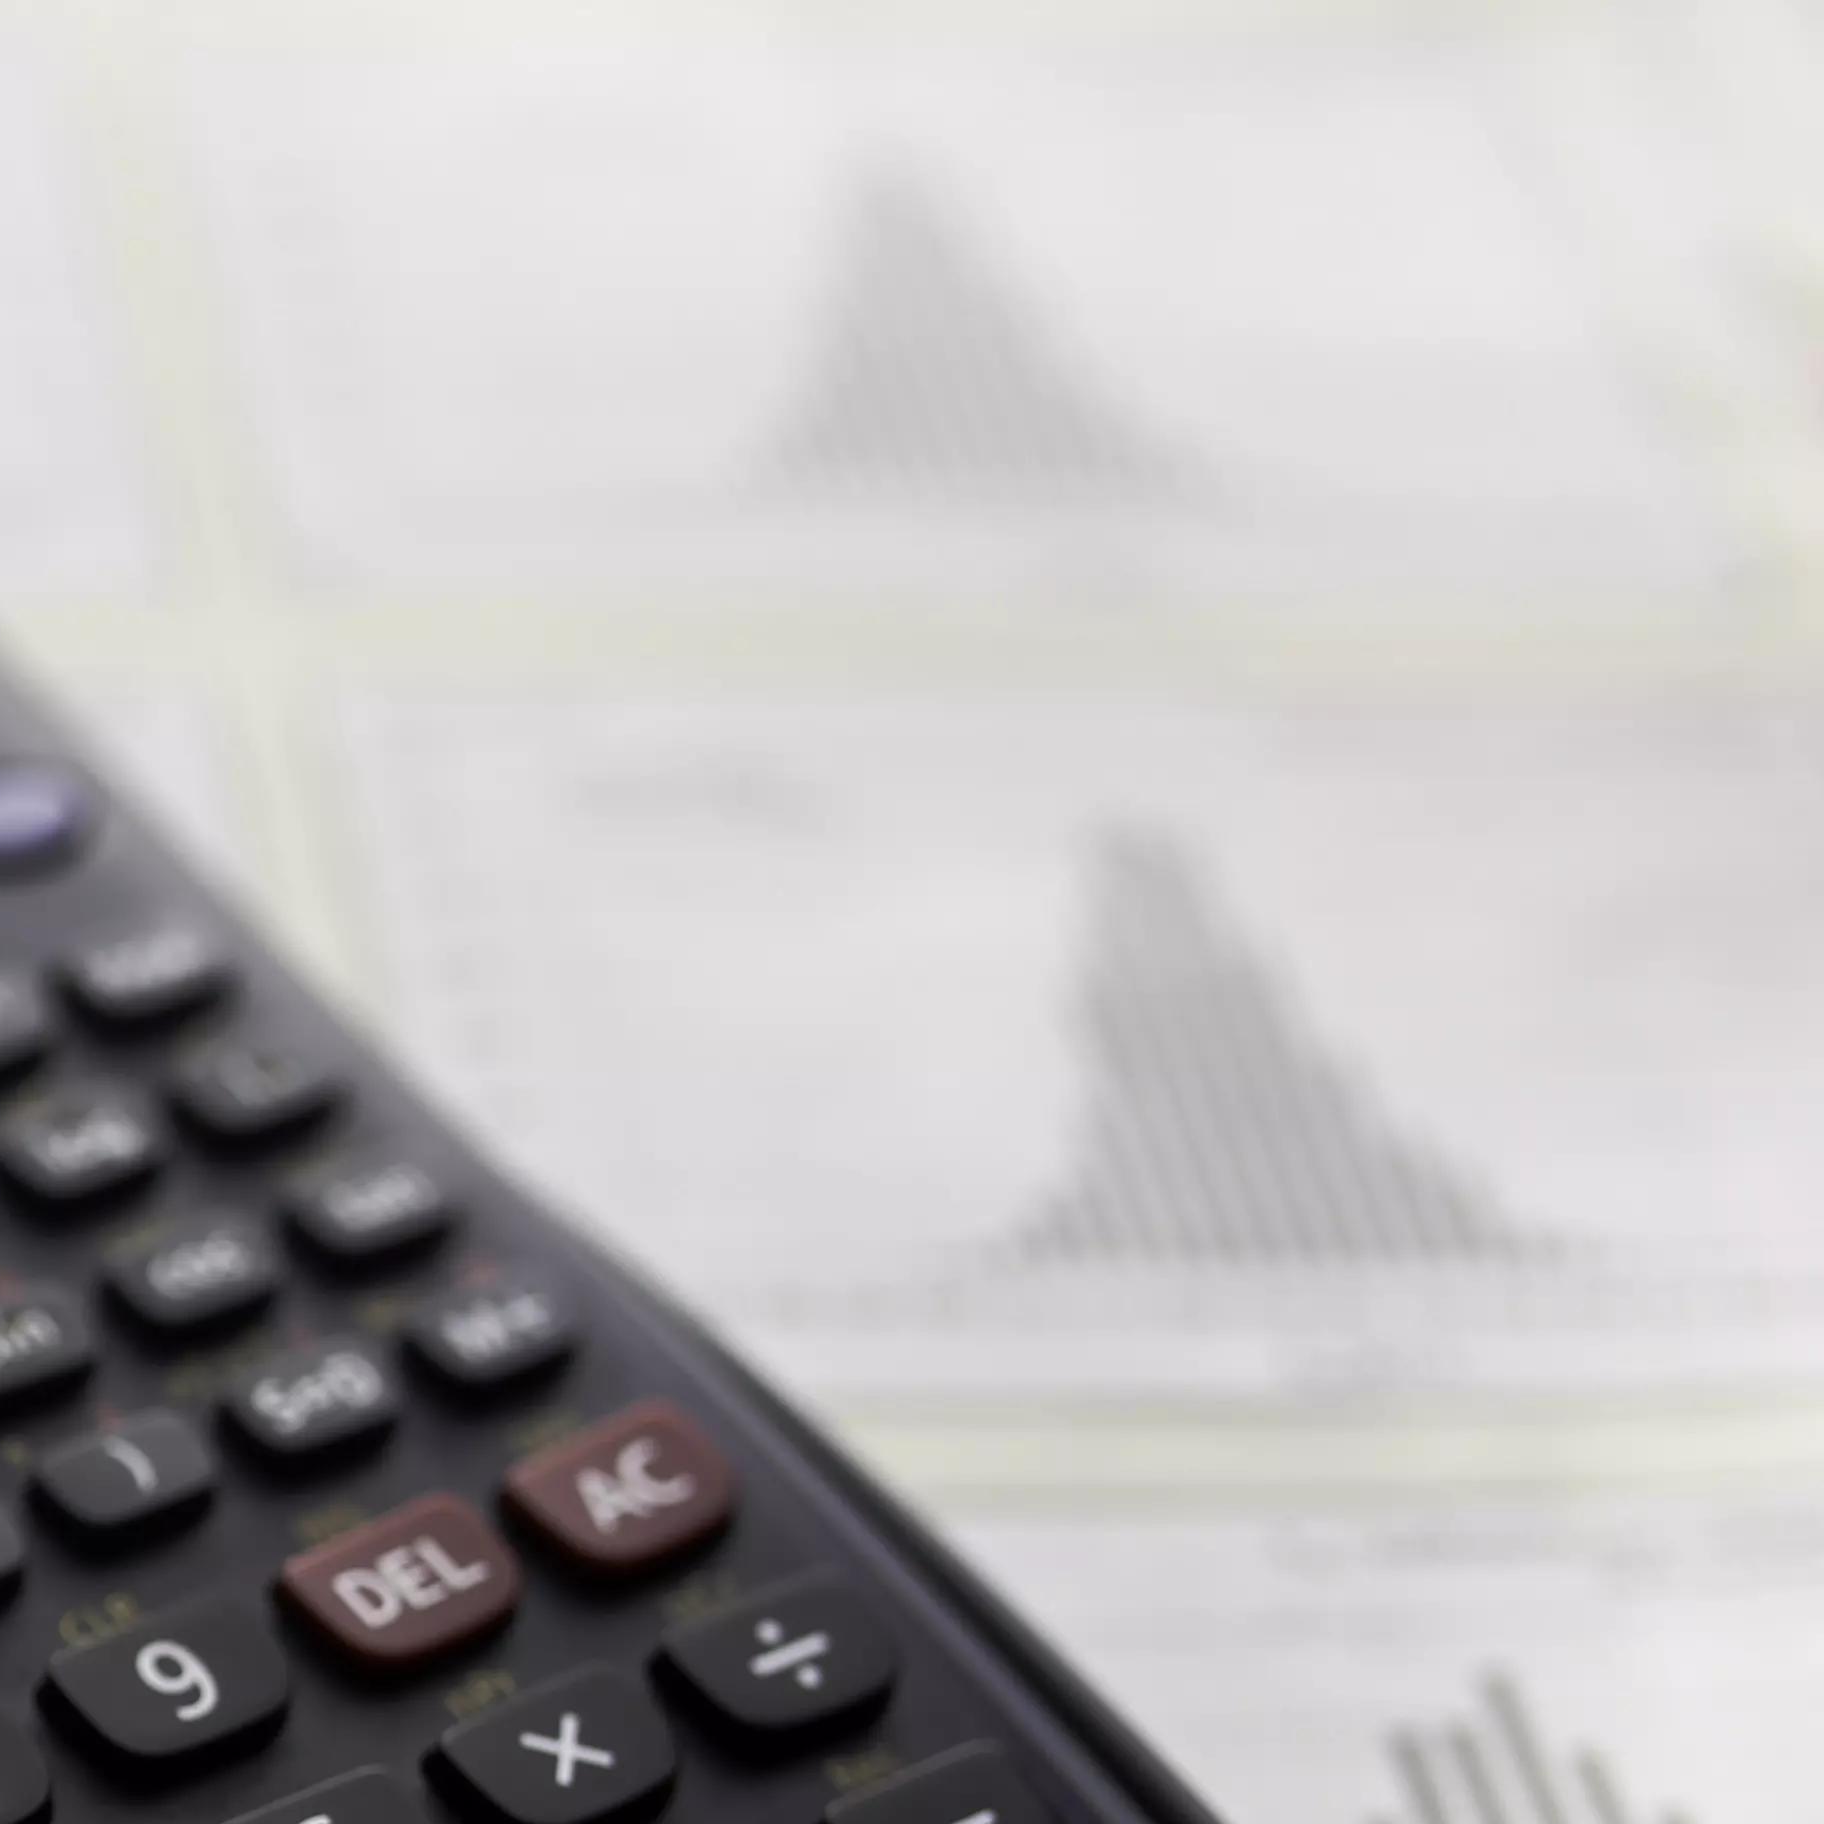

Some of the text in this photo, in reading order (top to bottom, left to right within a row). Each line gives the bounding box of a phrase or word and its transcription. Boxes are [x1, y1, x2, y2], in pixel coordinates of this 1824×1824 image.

[575, 1436, 695, 1533] AC
[332, 1534, 490, 1632] DEL
[135, 1639, 219, 1723] 9
